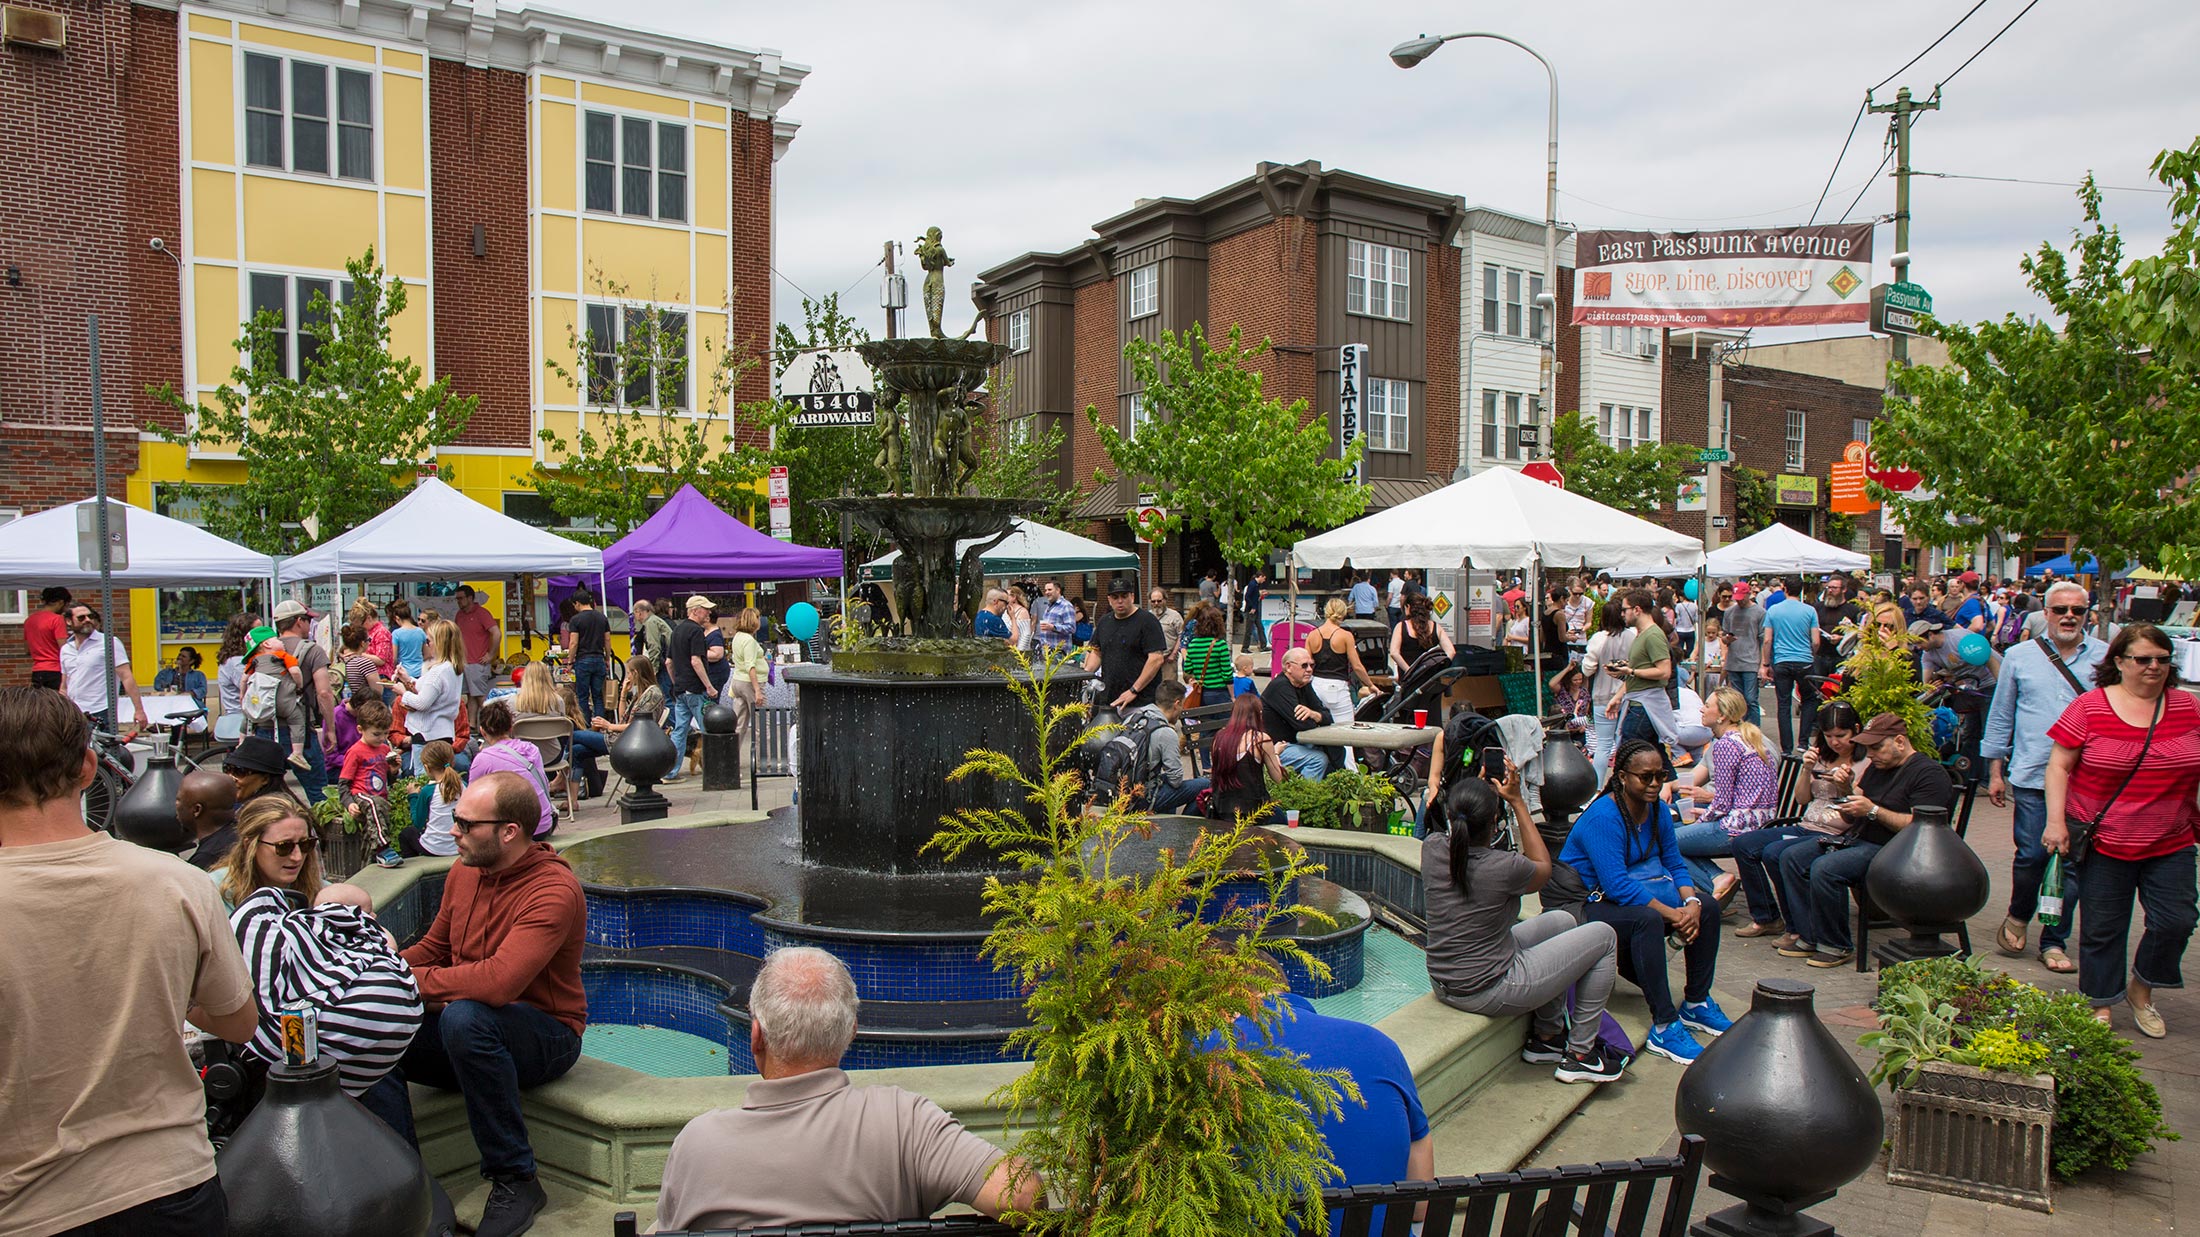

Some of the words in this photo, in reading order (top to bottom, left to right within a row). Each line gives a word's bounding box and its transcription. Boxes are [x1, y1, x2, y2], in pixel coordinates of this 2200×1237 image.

[1625, 271, 1670, 291] SHOP.
[1887, 287, 1921, 308] Passyunk
[1586, 311, 1707, 324] visiteastpassyunk.com
[1890, 313, 1903, 325] ONE
[798, 394, 859, 410] 1540
[788, 412, 872, 425] HARDWARE
[1341, 346, 1358, 484] STATESD
[1522, 431, 1533, 440] ONE
[1700, 452, 1720, 461] CROSS
[315, 587, 352, 595] LAMBRT
